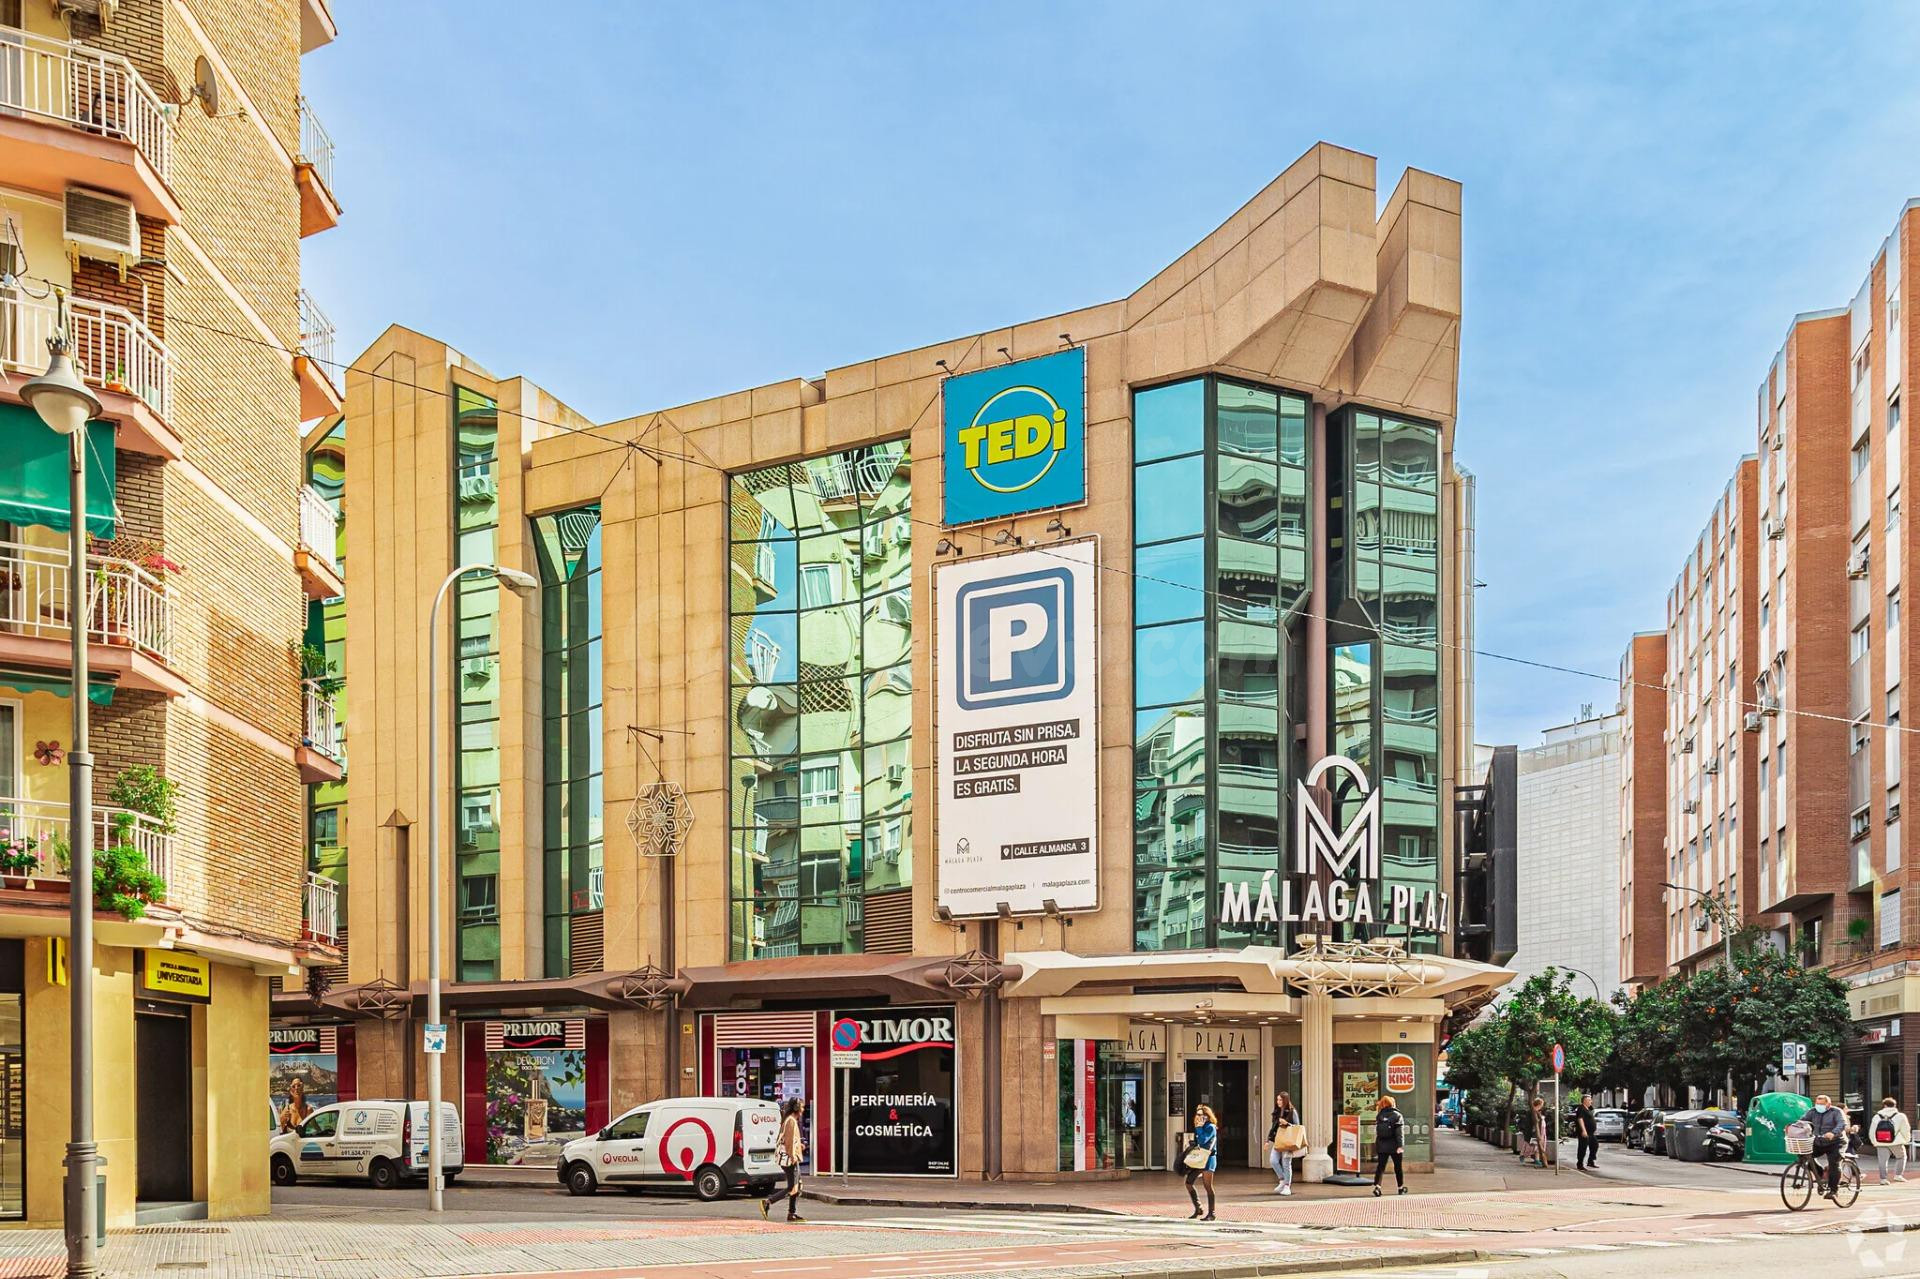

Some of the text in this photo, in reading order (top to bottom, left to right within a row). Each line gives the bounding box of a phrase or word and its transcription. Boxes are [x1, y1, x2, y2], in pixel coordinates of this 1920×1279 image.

[958, 408, 1067, 470] TEDi
[989, 603, 1049, 683] P
[956, 723, 1076, 749] DISFRUTA SIN PRISA,
[956, 748, 1065, 773] LA SEGUNDA HORA
[956, 778, 1017, 796] ES GRATIS.
[1014, 842, 1087, 856] CALLE ALMANSA 3
[1221, 870, 1450, 935] MÁLAGA PLAZ
[157, 970, 202, 986] UNIVERSITARIA
[503, 1022, 563, 1036] PRIMOR
[838, 1017, 954, 1043] RIMOR
[268, 1030, 318, 1043] PRIMOR
[1195, 1032, 1247, 1053] PLAZA
[516, 1055, 555, 1066] DEVOTION
[1388, 1066, 1414, 1074] BURGER
[1388, 1074, 1414, 1084] KING
[851, 1092, 937, 1106] PERFUMERÍA
[759, 1115, 777, 1123] VEOLIA
[889, 1108, 898, 1120] &
[855, 1123, 933, 1137] COSMÉTICA
[612, 1155, 639, 1164] VEOLIA
